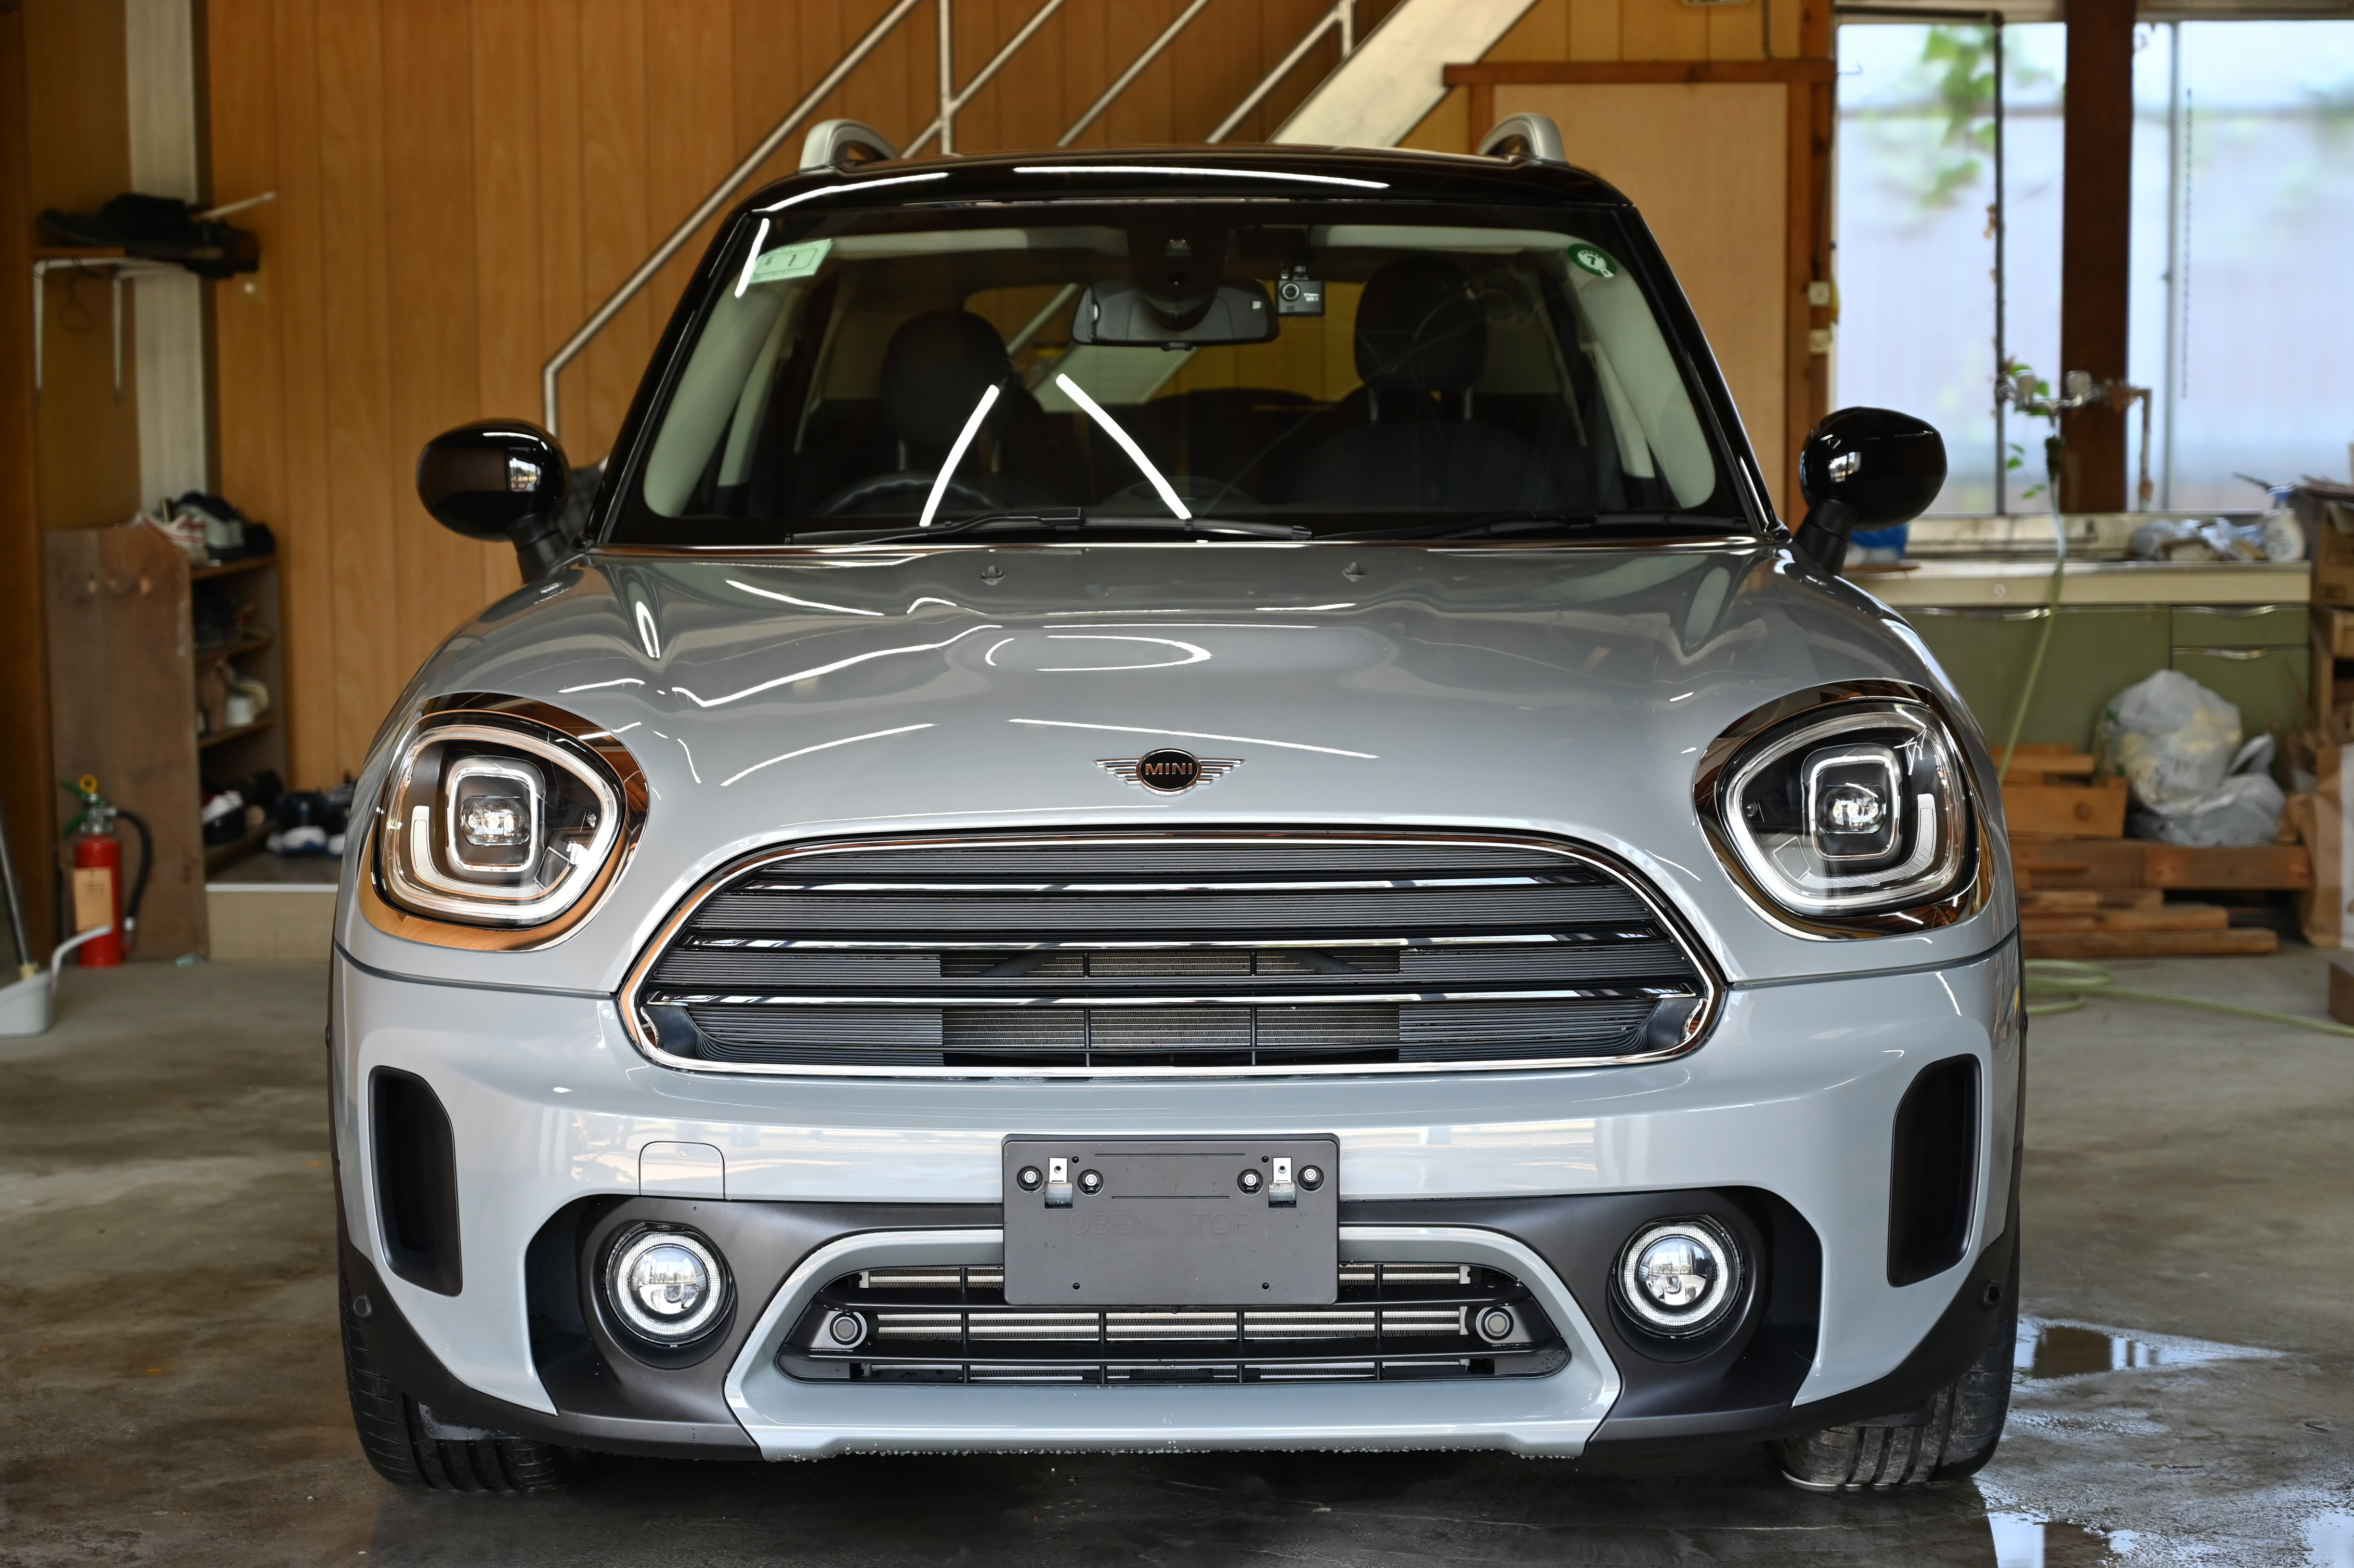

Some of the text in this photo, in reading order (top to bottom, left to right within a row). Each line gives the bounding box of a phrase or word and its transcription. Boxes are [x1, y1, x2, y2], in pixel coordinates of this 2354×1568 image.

[788, 253, 797, 267] 1
[1587, 256, 1596, 265] 7
[1145, 763, 1193, 775] MINI
[1069, 1212, 1252, 1235] OBEN TOP
